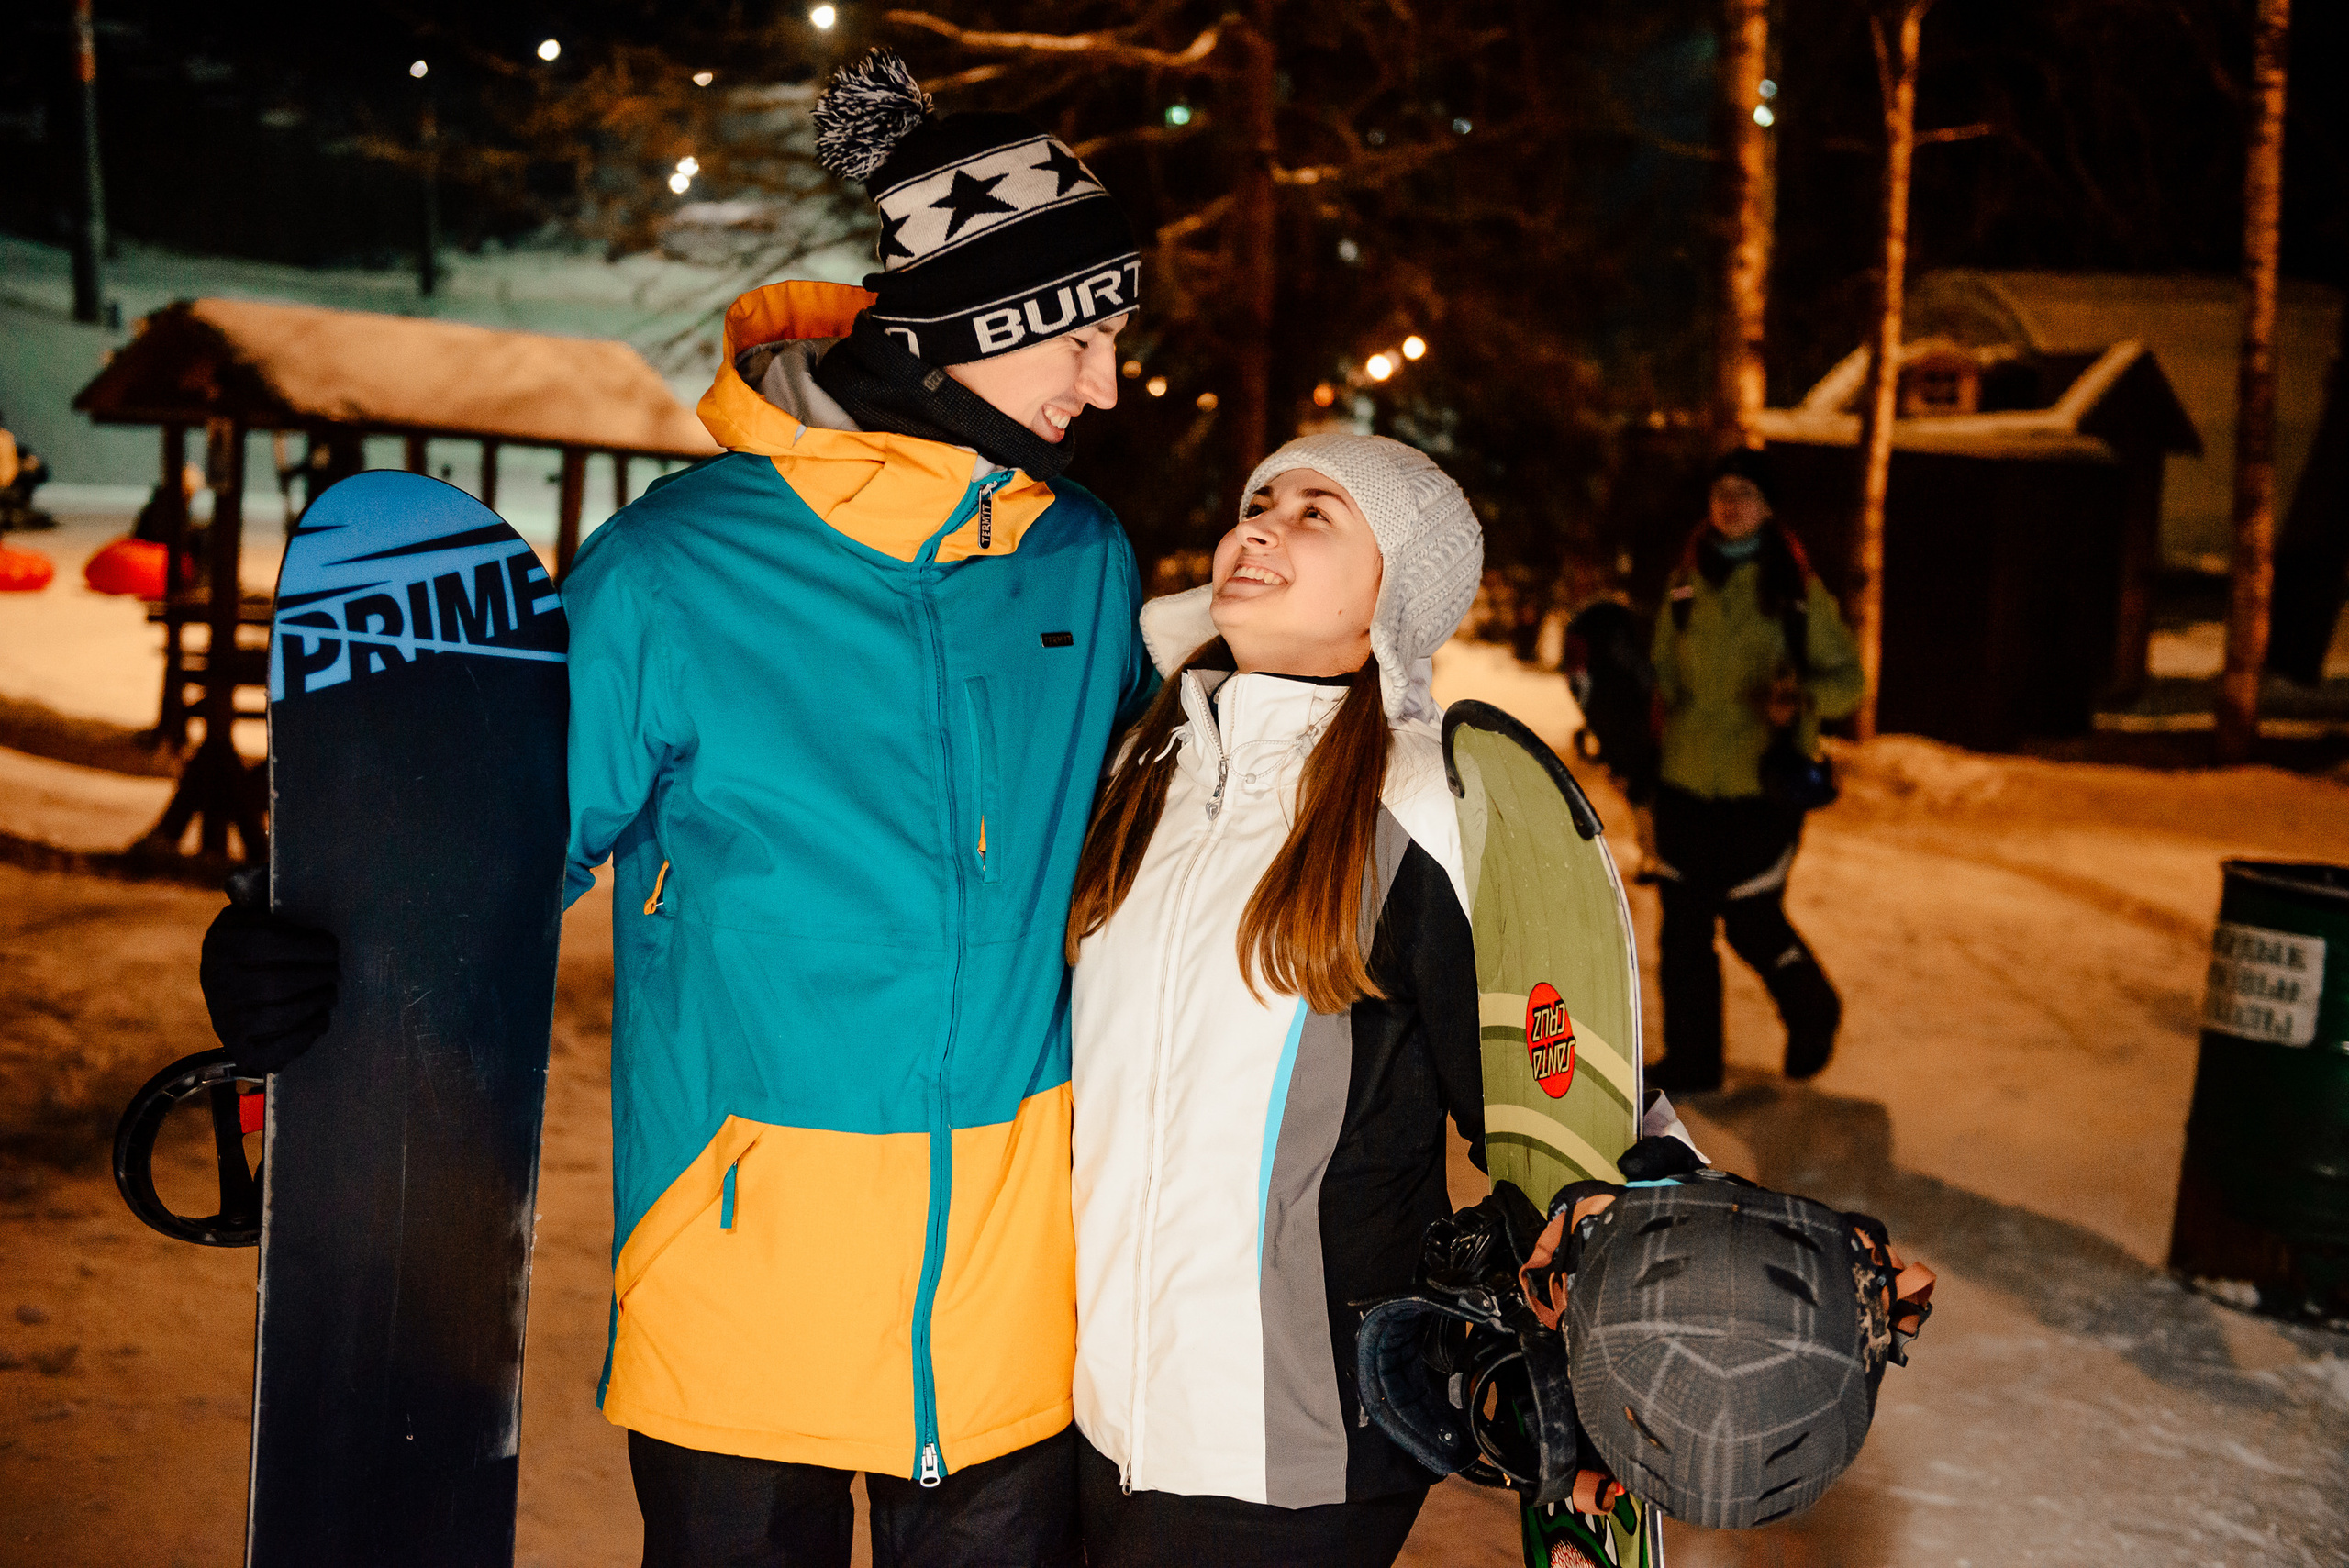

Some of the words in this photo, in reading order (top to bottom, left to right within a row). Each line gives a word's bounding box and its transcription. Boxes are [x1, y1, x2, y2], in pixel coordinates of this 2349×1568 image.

[981, 502, 992, 544] TERMIT
[278, 550, 566, 700] PRIME
[1531, 999, 1566, 1042] CRUZ
[1531, 1038, 1576, 1081] SANTA
